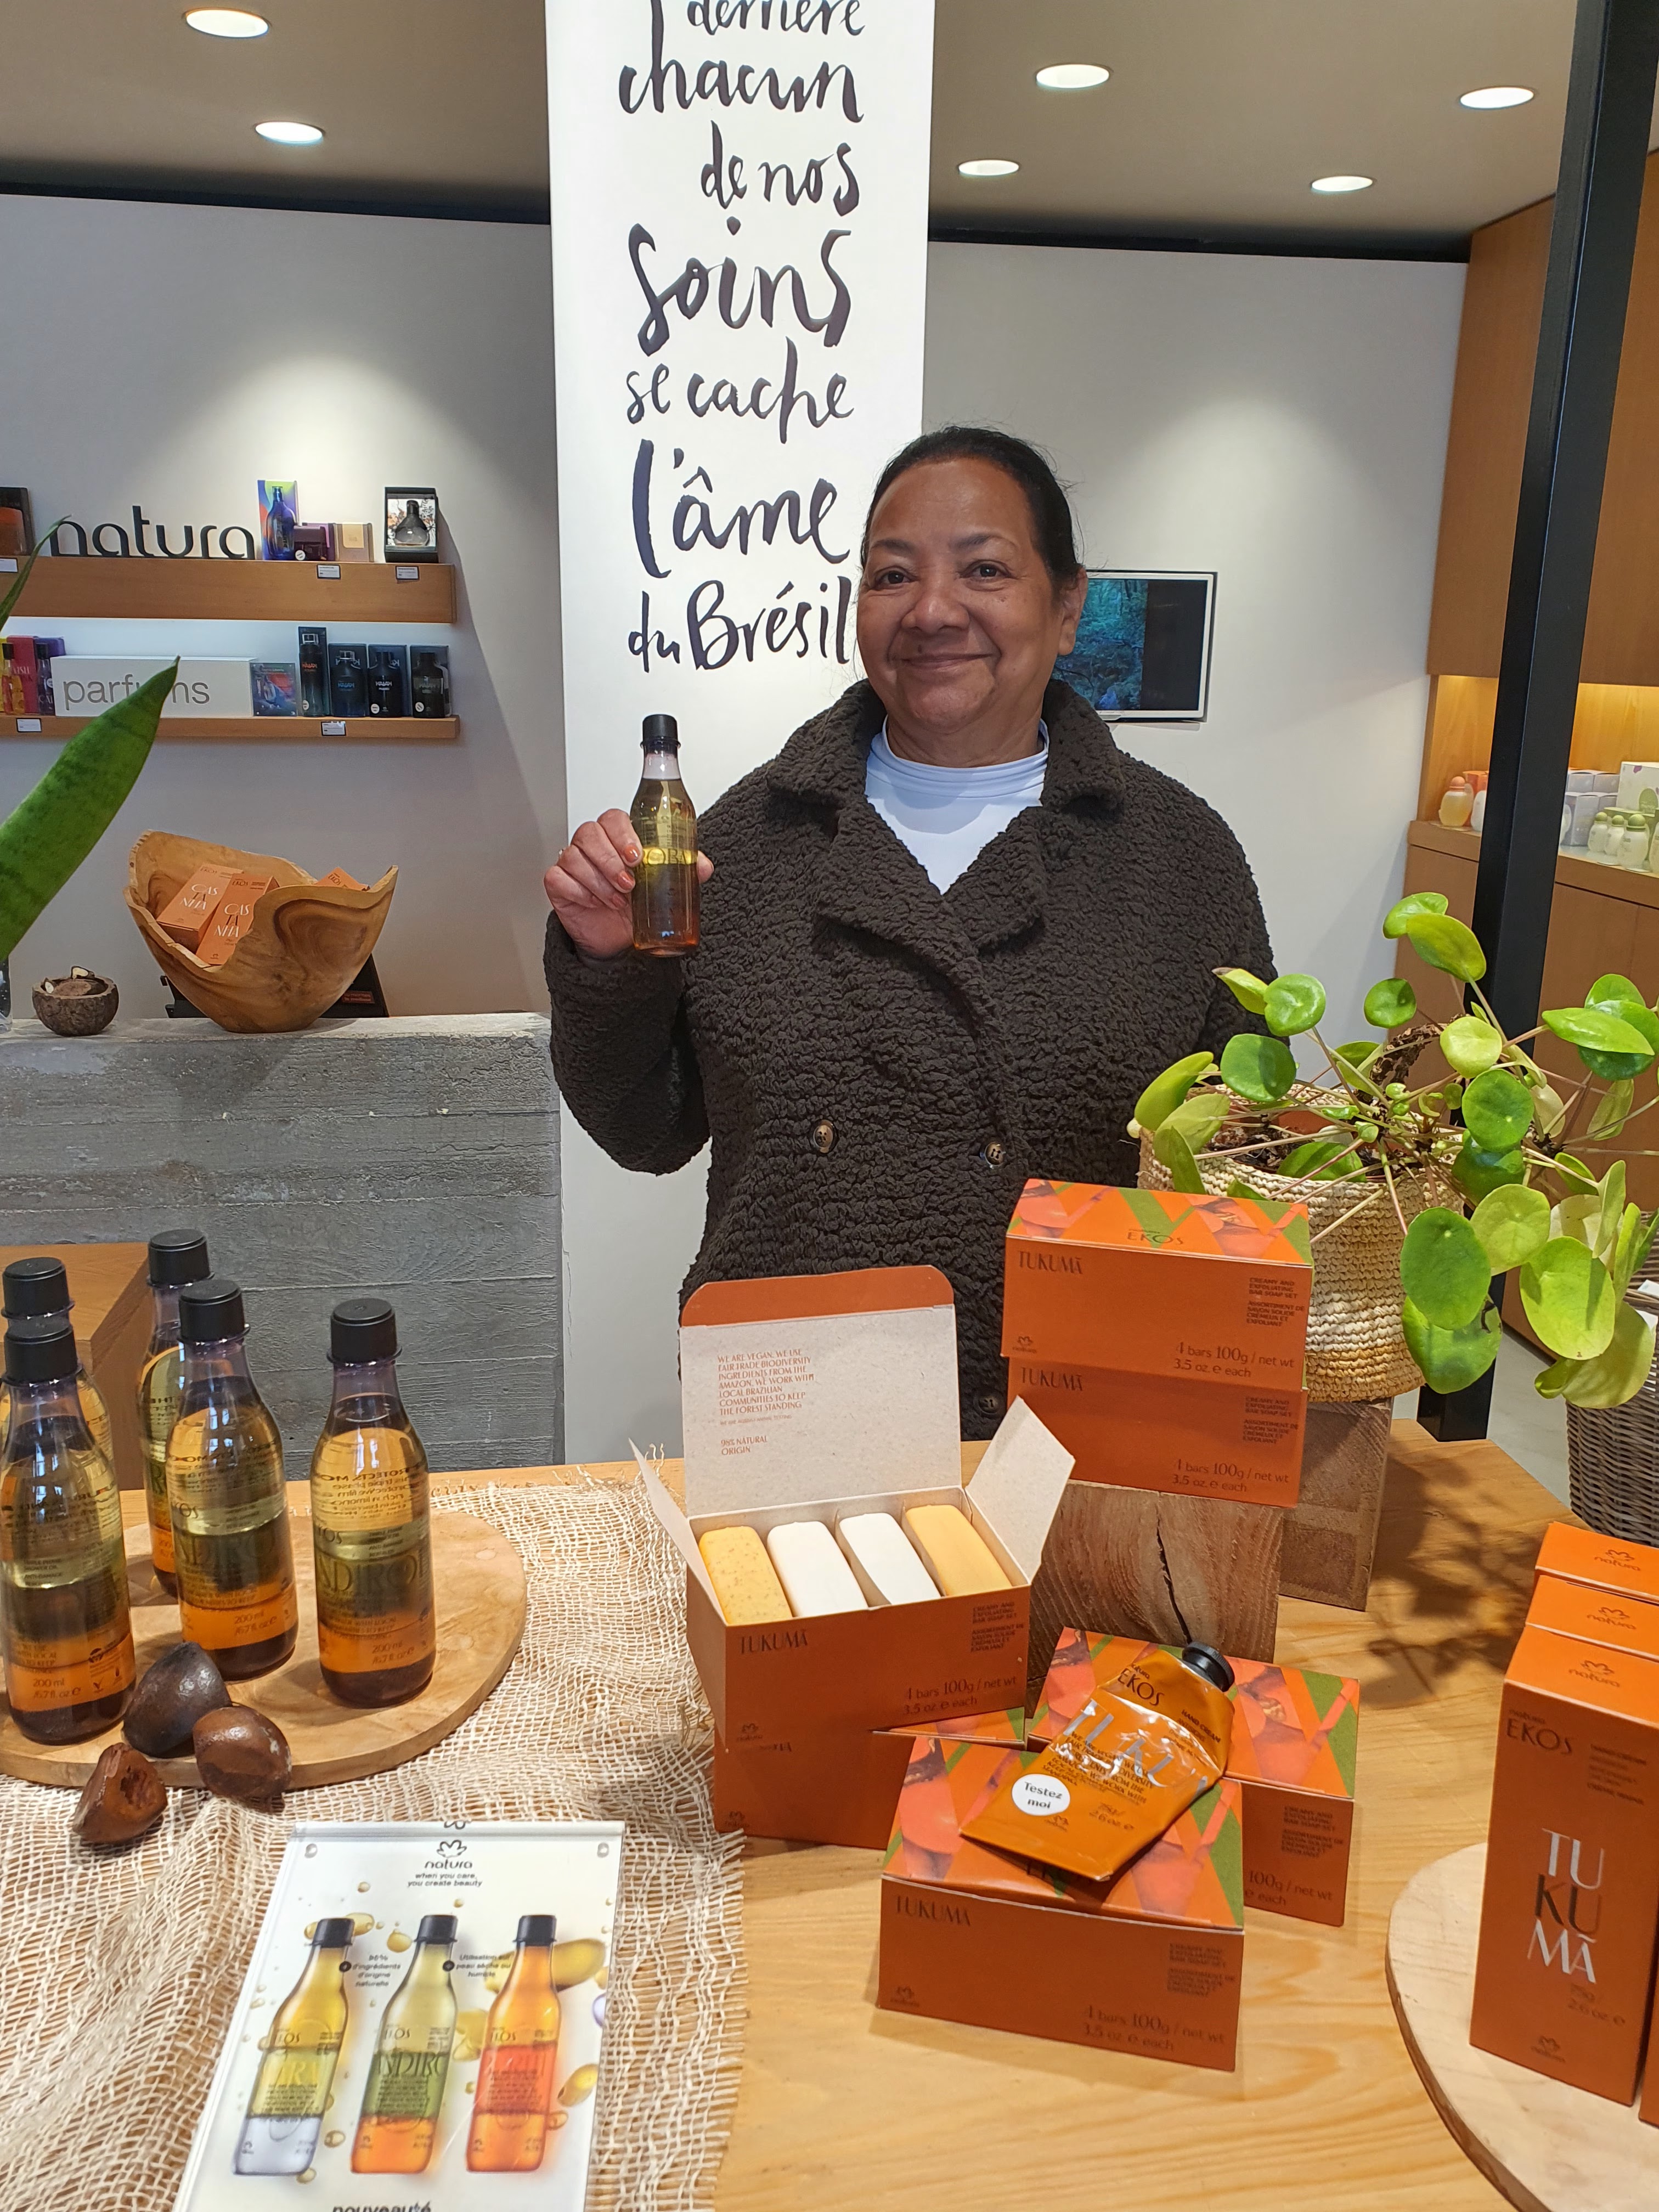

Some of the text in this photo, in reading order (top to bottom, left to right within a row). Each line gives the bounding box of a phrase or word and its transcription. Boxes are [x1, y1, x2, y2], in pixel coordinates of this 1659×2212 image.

[619, 0, 864, 122] chacun
[701, 120, 860, 216] de nos
[627, 336, 854, 444] se cache
[632, 439, 850, 578] l'âme
[49, 505, 256, 560] natura
[628, 575, 850, 673] du Brésil
[63, 674, 210, 711] parfms
[224, 903, 251, 916] CAS
[1127, 1231, 1184, 1245] EKOS
[717, 1355, 729, 1363] WE
[718, 1357, 811, 1372] FAIR TRADE BIODIVERSITY
[1187, 1345, 1212, 1358] bars
[1216, 1345, 1248, 1364] 100g
[1258, 1356, 1277, 1365] net
[1279, 1358, 1294, 1368] wt
[719, 1370, 768, 1381] INGREDIENTS
[769, 1368, 792, 1376] FROM
[1173, 1357, 1192, 1370] 3.5
[1224, 1367, 1251, 1378] each
[755, 1378, 766, 1386] WE
[769, 1376, 793, 1385] WORK
[719, 1386, 782, 1398] LOCAL BRAZILIAN
[719, 1396, 774, 1407] COMMUNITIES
[788, 1391, 806, 1400] KEEP
[736, 1404, 763, 1414] FOREST
[764, 1401, 802, 1411] STANDING
[720, 1435, 768, 1446] 98% NATURAL
[721, 1446, 751, 1455] ORIGIN
[1185, 1462, 1209, 1474] bars
[1214, 1463, 1244, 1480] 100g
[1254, 1471, 1272, 1480] net
[1274, 1474, 1289, 1483] wt
[1172, 1474, 1190, 1485] 3.5
[1221, 1482, 1247, 1492] each
[1594, 1556, 1641, 1572] natura
[1587, 1613, 1637, 1630] natura
[1118, 1668, 1165, 1706] EKOS
[1568, 1668, 1621, 1688] natura
[916, 1687, 940, 1700] bars
[944, 1679, 974, 1695] 100g
[984, 1678, 1001, 1689] net
[1003, 1676, 1017, 1686] wt
[904, 1702, 921, 1714] 3.5
[952, 1695, 978, 1707] each
[1506, 1718, 1575, 1755] EKOS
[1104, 1758, 1153, 1789] BDIVERSITY
[1024, 1781, 1063, 1799] Testez
[1027, 1799, 1051, 1809] moi
[424, 1859, 473, 1870] natura
[1541, 1827, 1605, 1889] TU
[454, 1880, 483, 1888] beauty
[1249, 1870, 1283, 1892] 100g
[1295, 1884, 1313, 1897] net
[1257, 1894, 1286, 1906] each
[1536, 1873, 1602, 1936] KU
